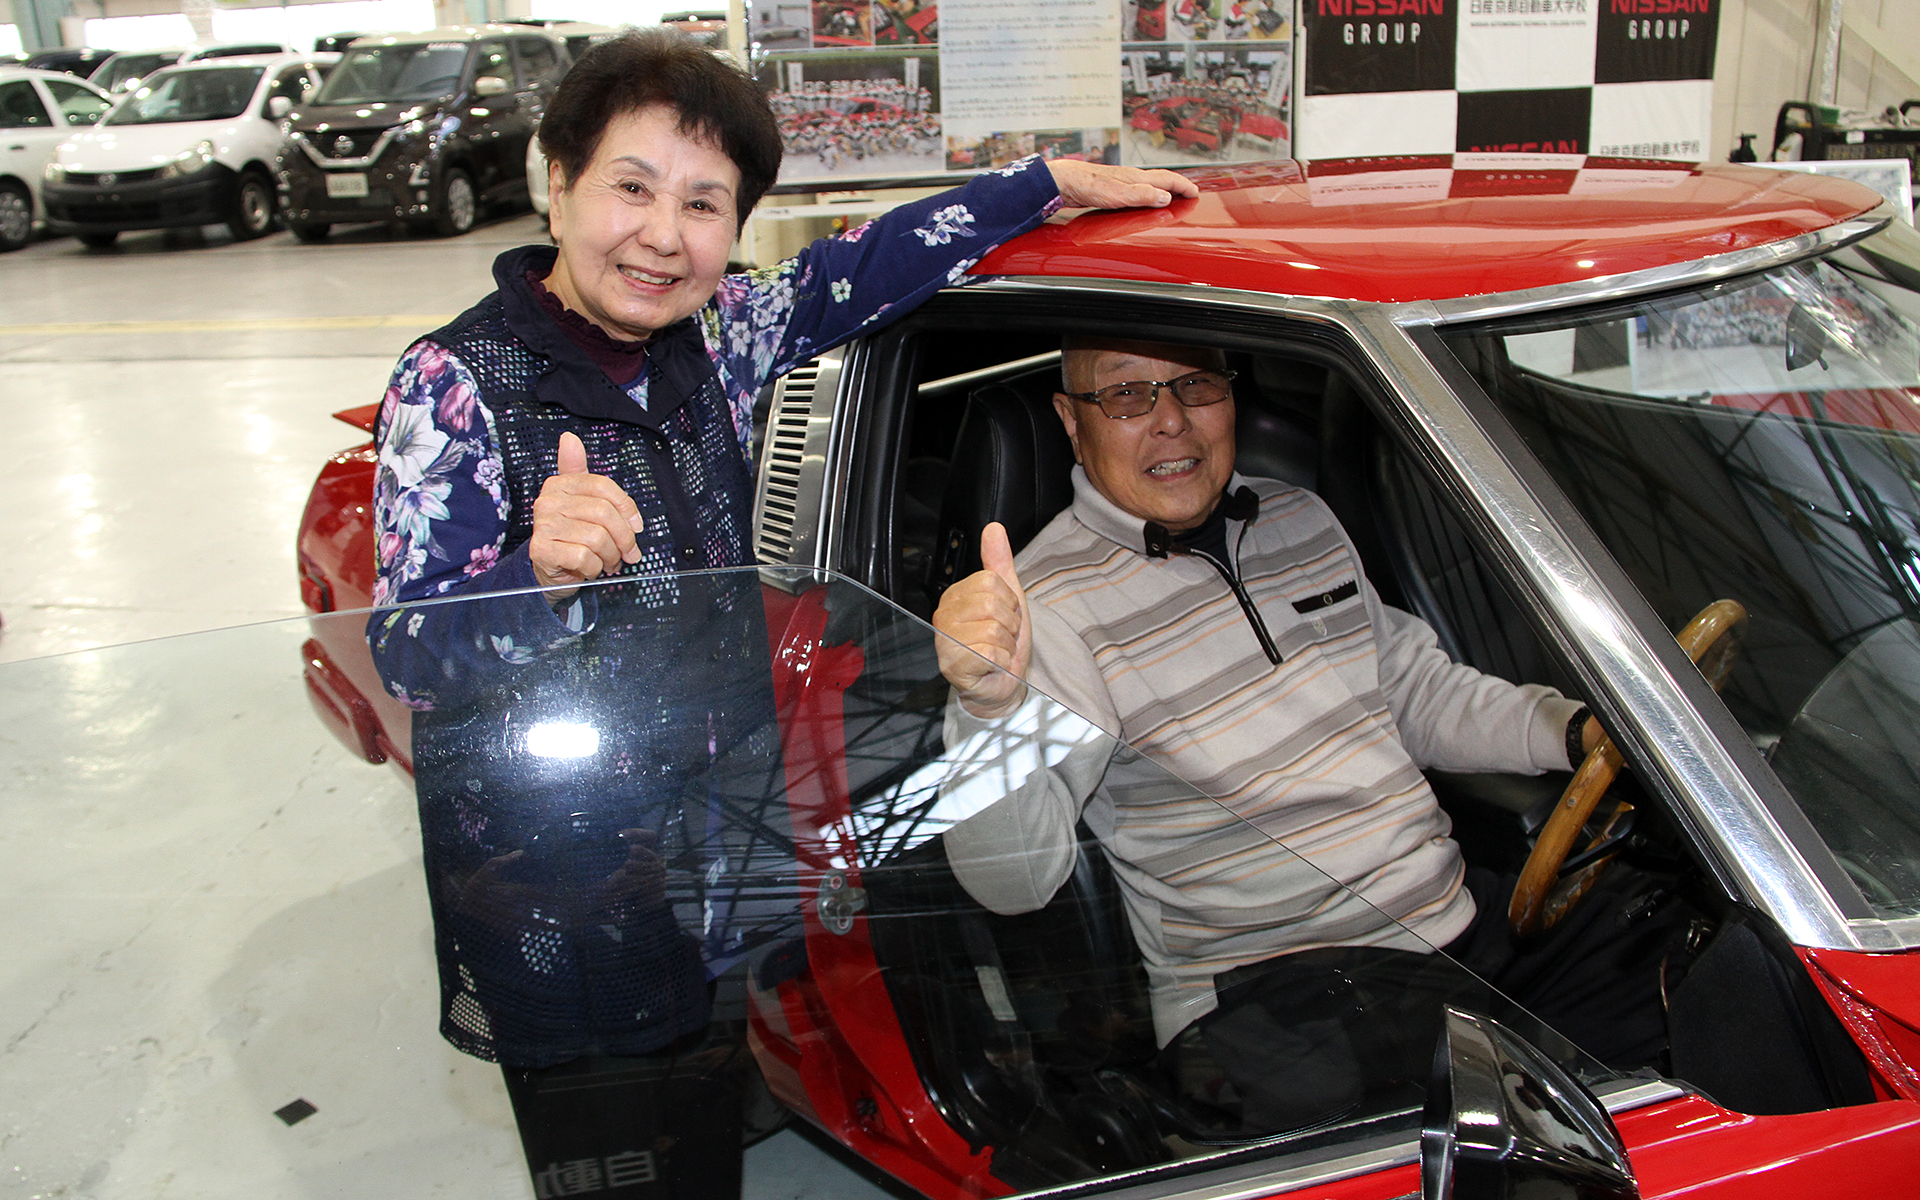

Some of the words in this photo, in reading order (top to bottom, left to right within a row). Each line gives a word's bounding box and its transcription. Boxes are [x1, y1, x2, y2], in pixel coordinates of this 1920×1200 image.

[1318, 0, 1444, 16] NISSAN
[1611, 0, 1709, 14] NISSAN
[1343, 22, 1421, 45] GROUP
[1628, 19, 1690, 40] GROUP
